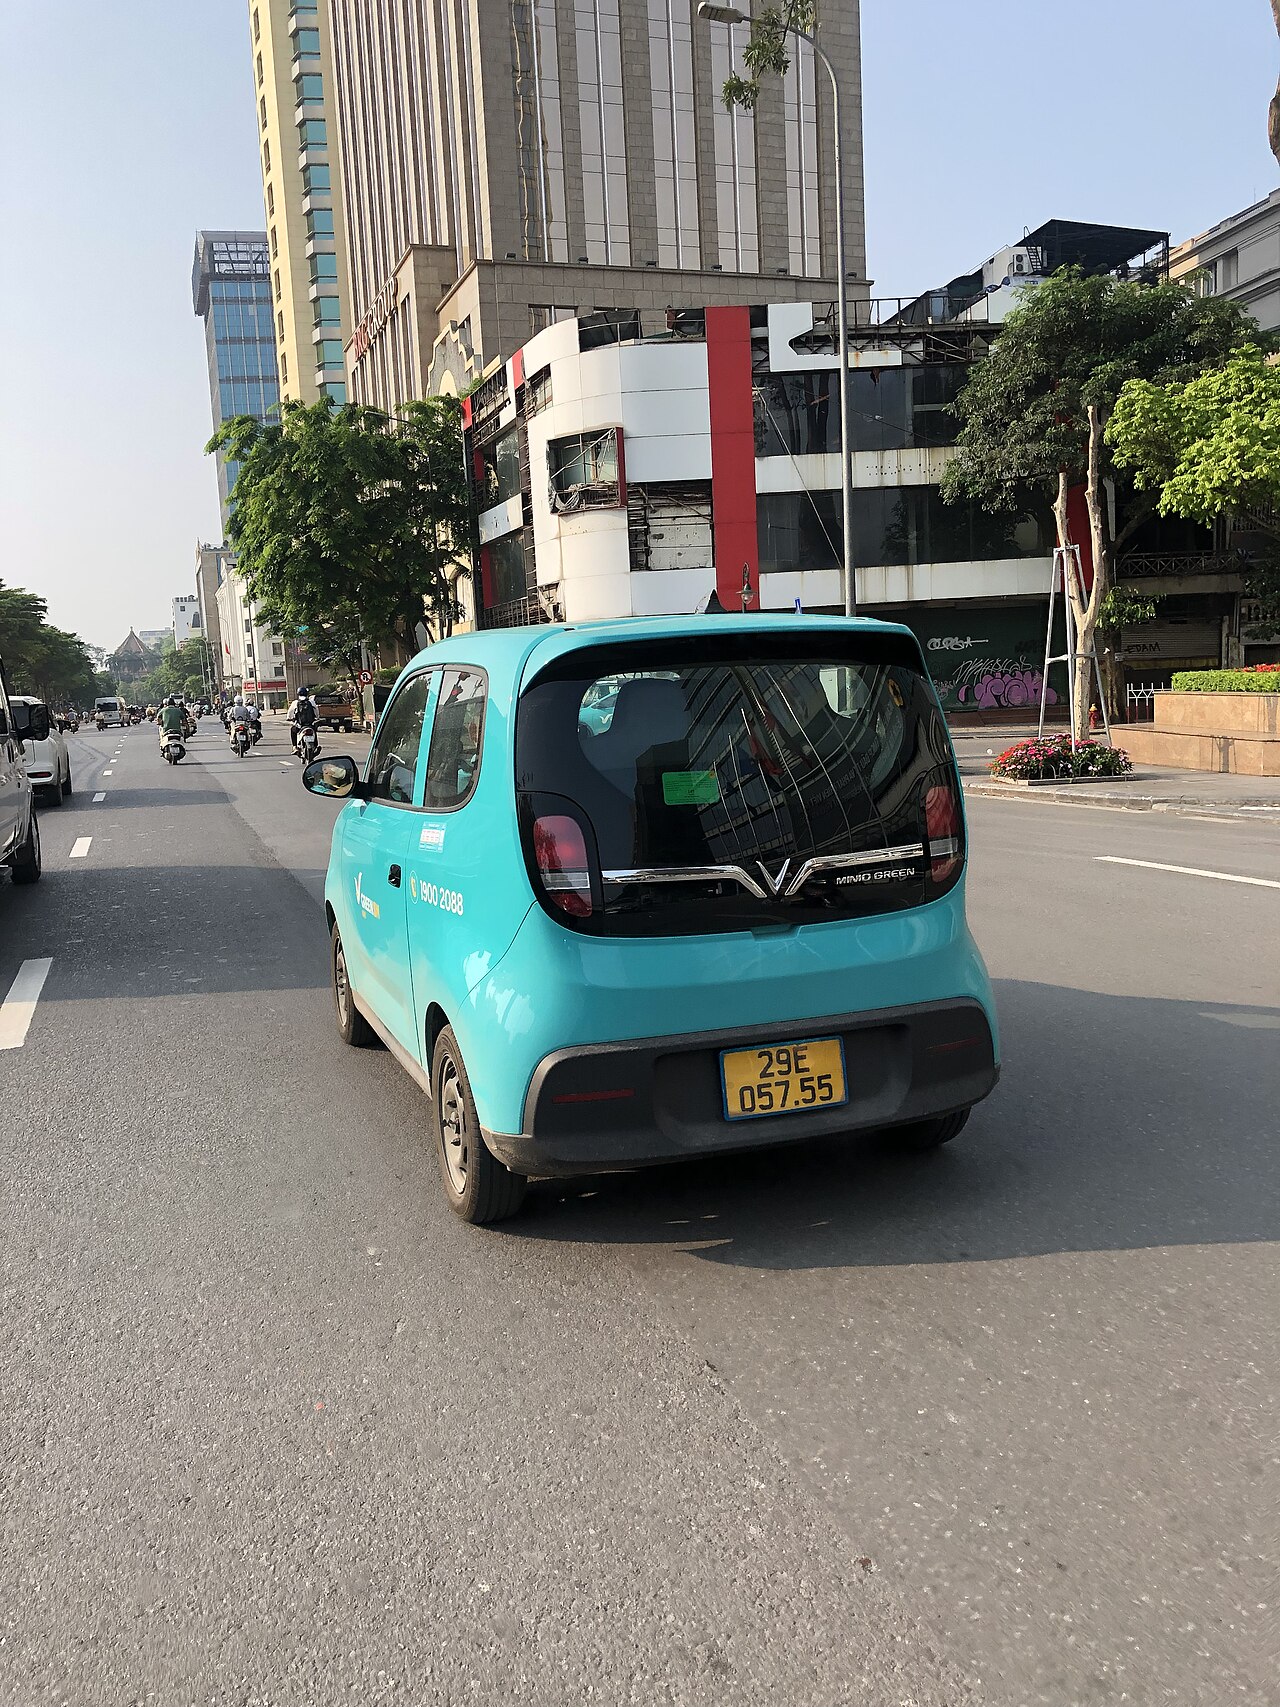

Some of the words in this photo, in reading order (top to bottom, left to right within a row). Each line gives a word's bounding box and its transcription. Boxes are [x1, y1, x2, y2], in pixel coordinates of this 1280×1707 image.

[836, 873, 872, 885] MINIO
[873, 867, 915, 880] GREEN
[420, 880, 438, 907] 1900
[440, 887, 464, 916] 2088
[757, 1045, 810, 1078] 29E
[739, 1073, 834, 1113] 057.55
